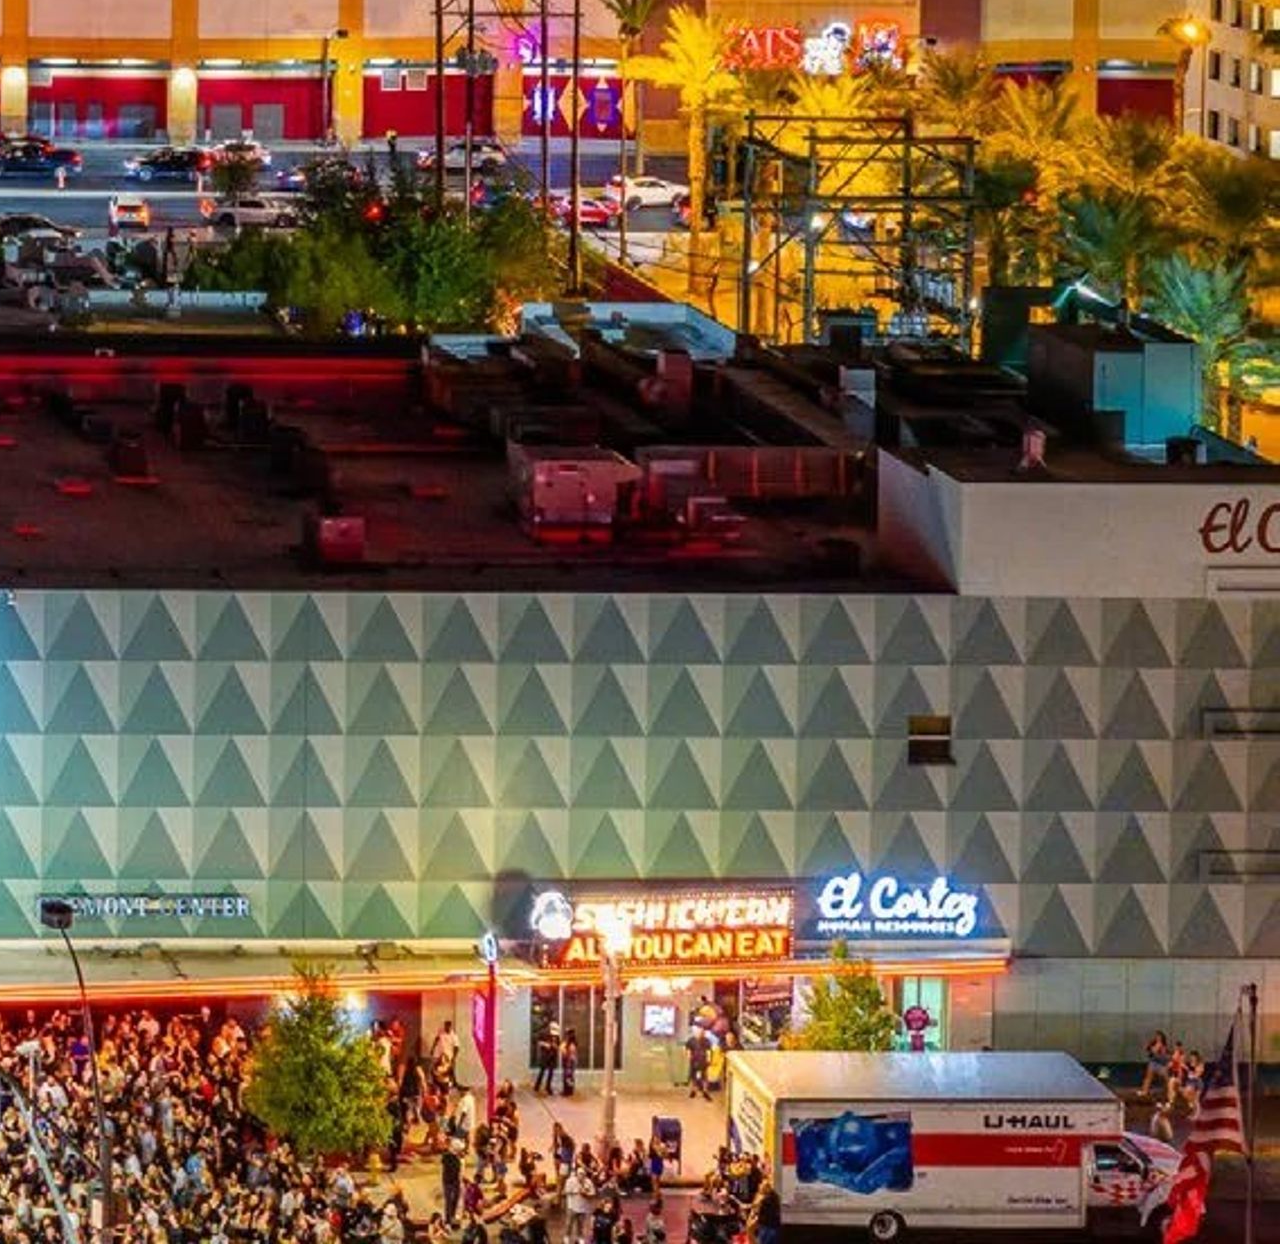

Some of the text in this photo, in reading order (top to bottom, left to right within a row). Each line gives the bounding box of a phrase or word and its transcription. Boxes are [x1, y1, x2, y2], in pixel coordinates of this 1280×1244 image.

[724, 27, 801, 62] ATS
[1199, 498, 1254, 554] El
[159, 894, 251, 918] CENTER
[571, 897, 665, 931] SSHI
[817, 871, 979, 937] El Cortez
[675, 930, 733, 959] CAN
[736, 929, 788, 958] EAT
